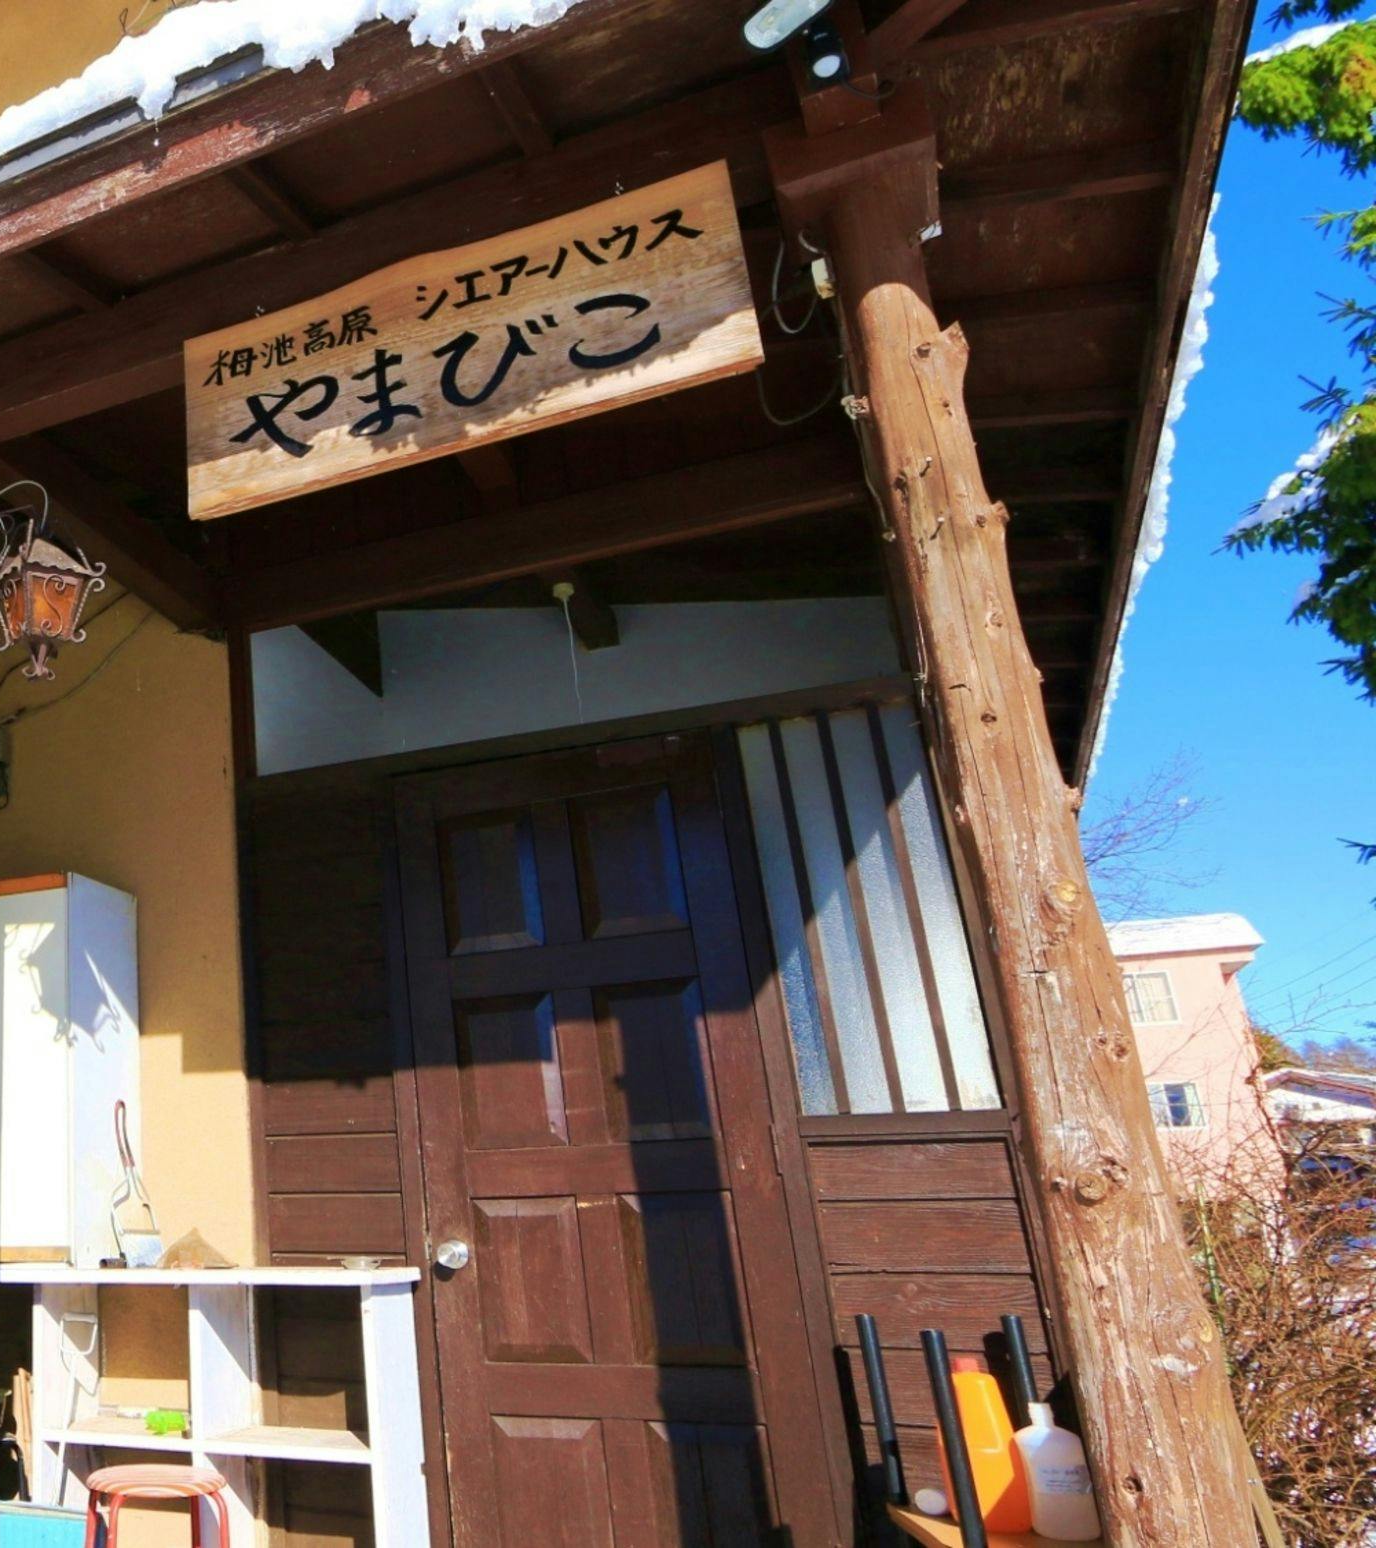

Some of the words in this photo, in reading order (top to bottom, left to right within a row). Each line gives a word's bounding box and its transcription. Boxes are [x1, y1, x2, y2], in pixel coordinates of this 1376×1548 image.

[202, 305, 378, 387] 栂池高原
[229, 293, 661, 458] やまびこ
